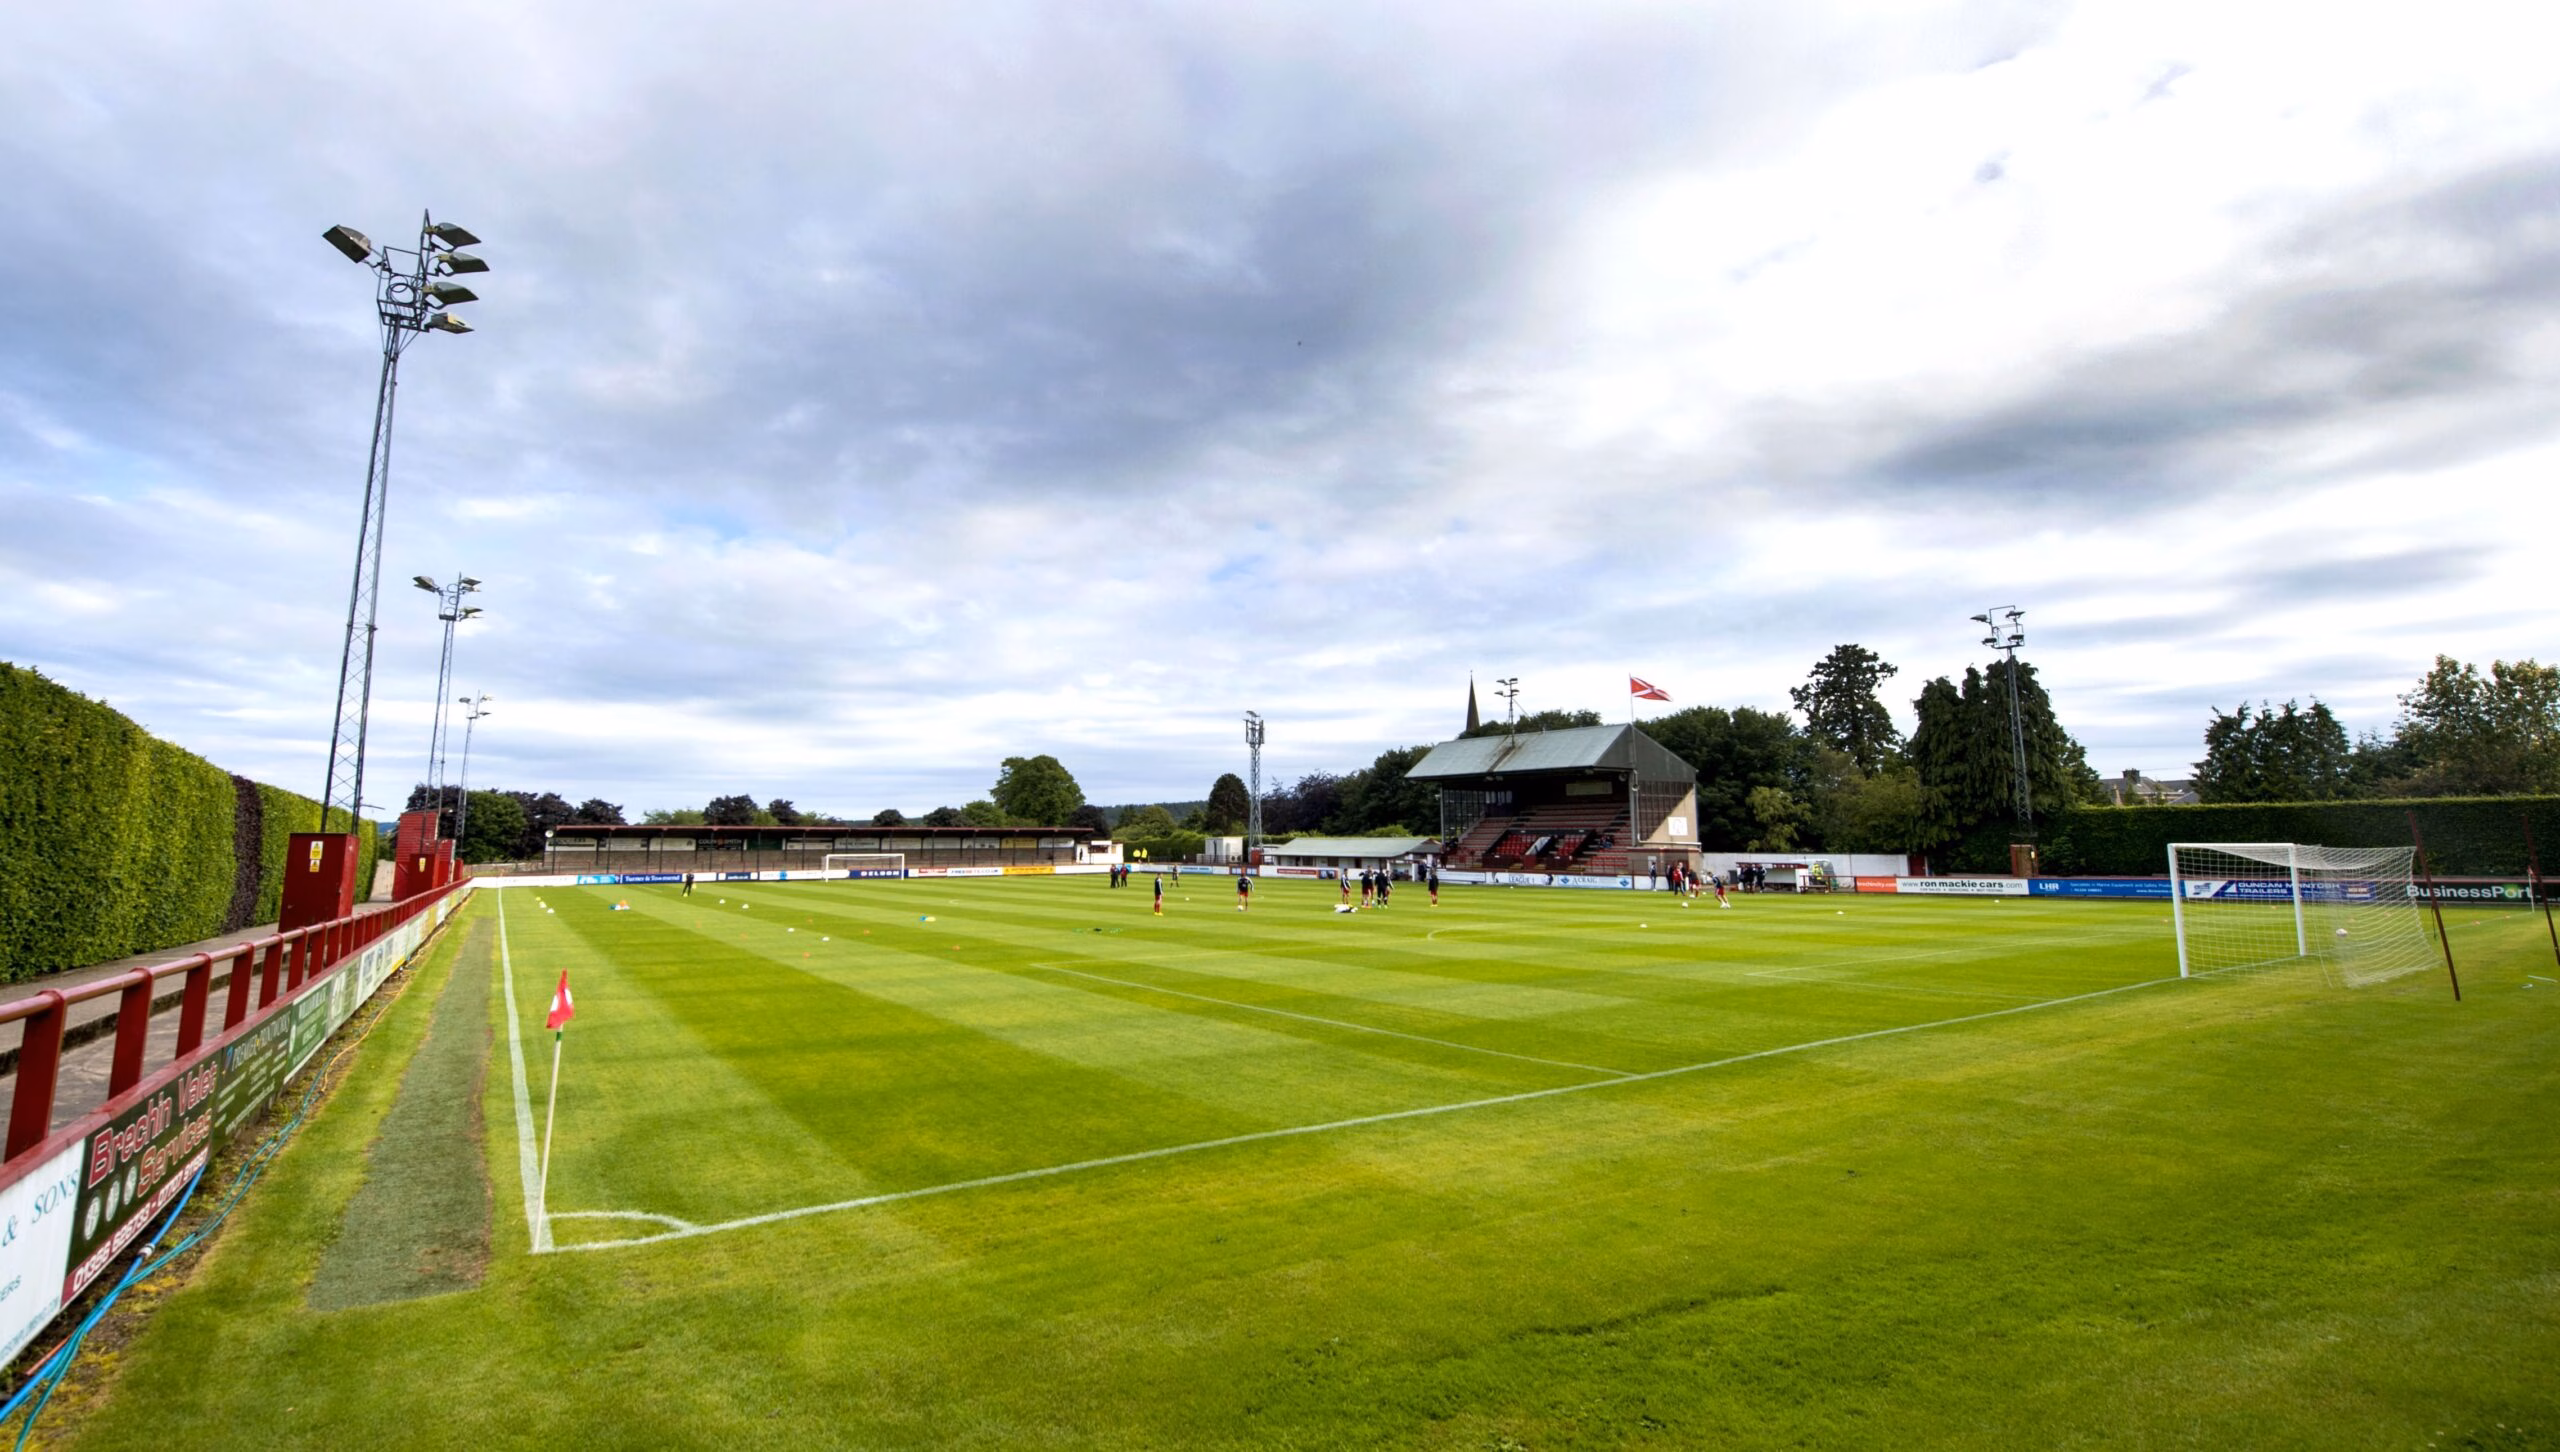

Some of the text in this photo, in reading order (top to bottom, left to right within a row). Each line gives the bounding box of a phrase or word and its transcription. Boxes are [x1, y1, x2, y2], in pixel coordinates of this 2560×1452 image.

[1508, 875, 1530, 884] LEAGUE
[1939, 880, 1977, 888] mackie
[2039, 882, 2060, 890] LHR
[2406, 884, 2533, 899] BusinessPort
[88, 1091, 172, 1190] Brechin
[178, 1060, 218, 1117] Valet
[137, 1107, 212, 1198] Services
[2, 1169, 79, 1247] & SONS
